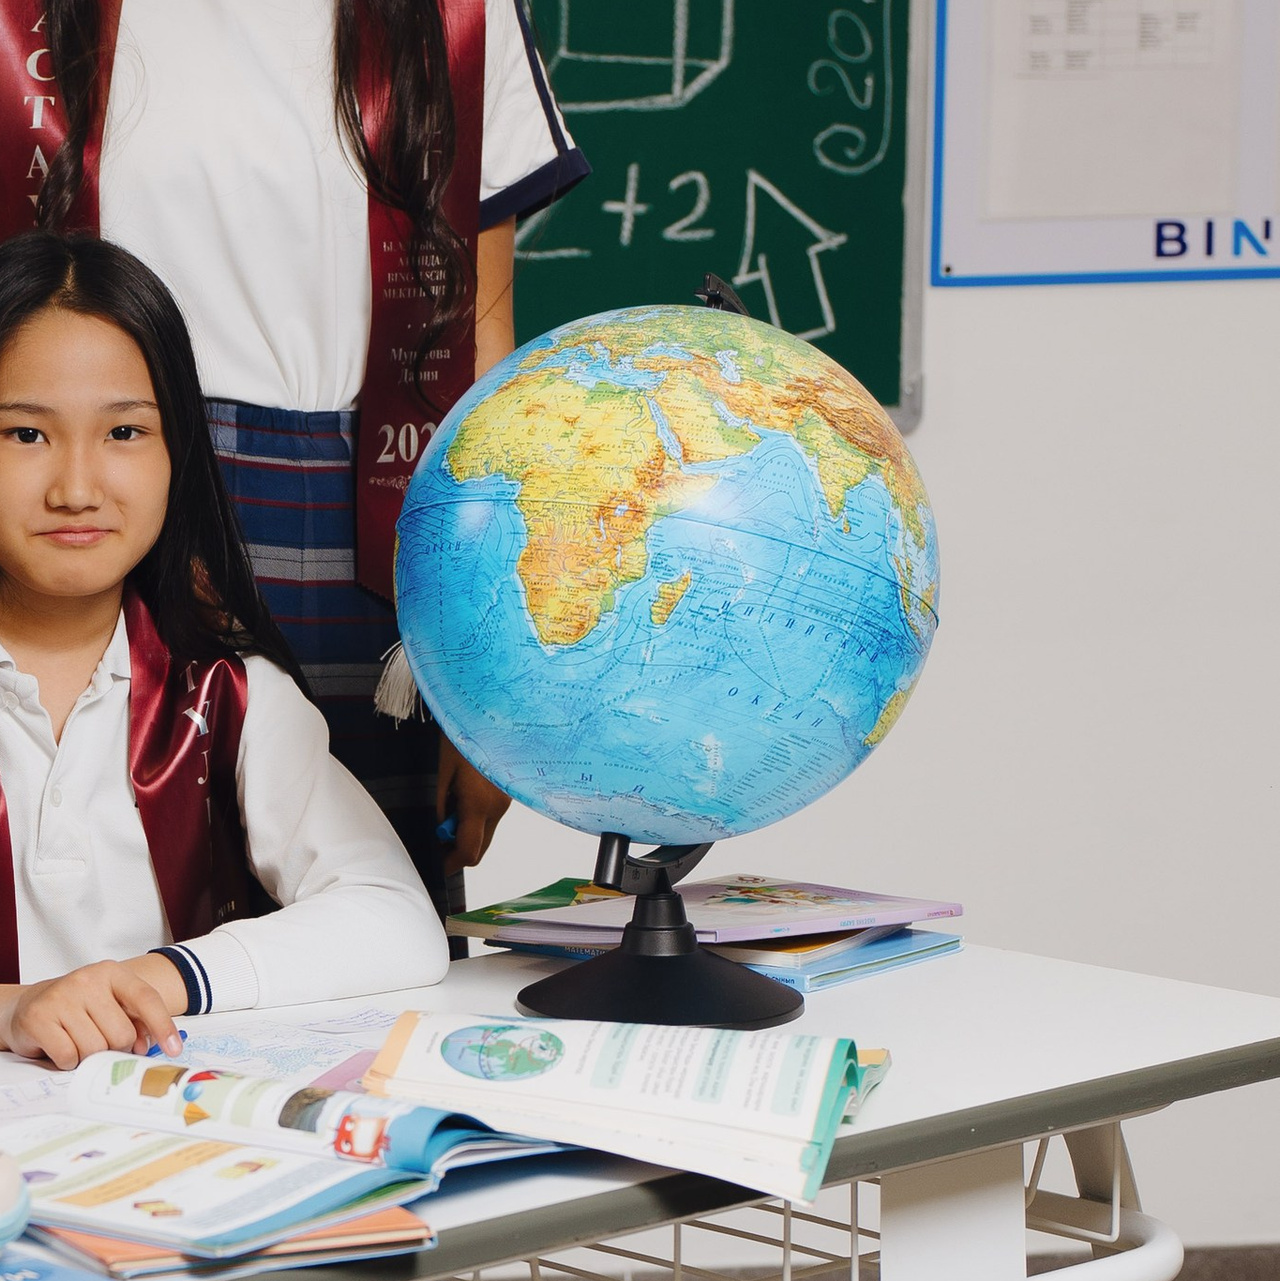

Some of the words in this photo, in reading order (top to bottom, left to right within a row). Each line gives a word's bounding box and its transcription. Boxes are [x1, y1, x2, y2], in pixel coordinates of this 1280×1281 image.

[1155, 219, 1271, 258] BIN
[727, 686, 824, 729] ОКЕАН
[564, 946, 609, 957] МАТЕМАТИ
